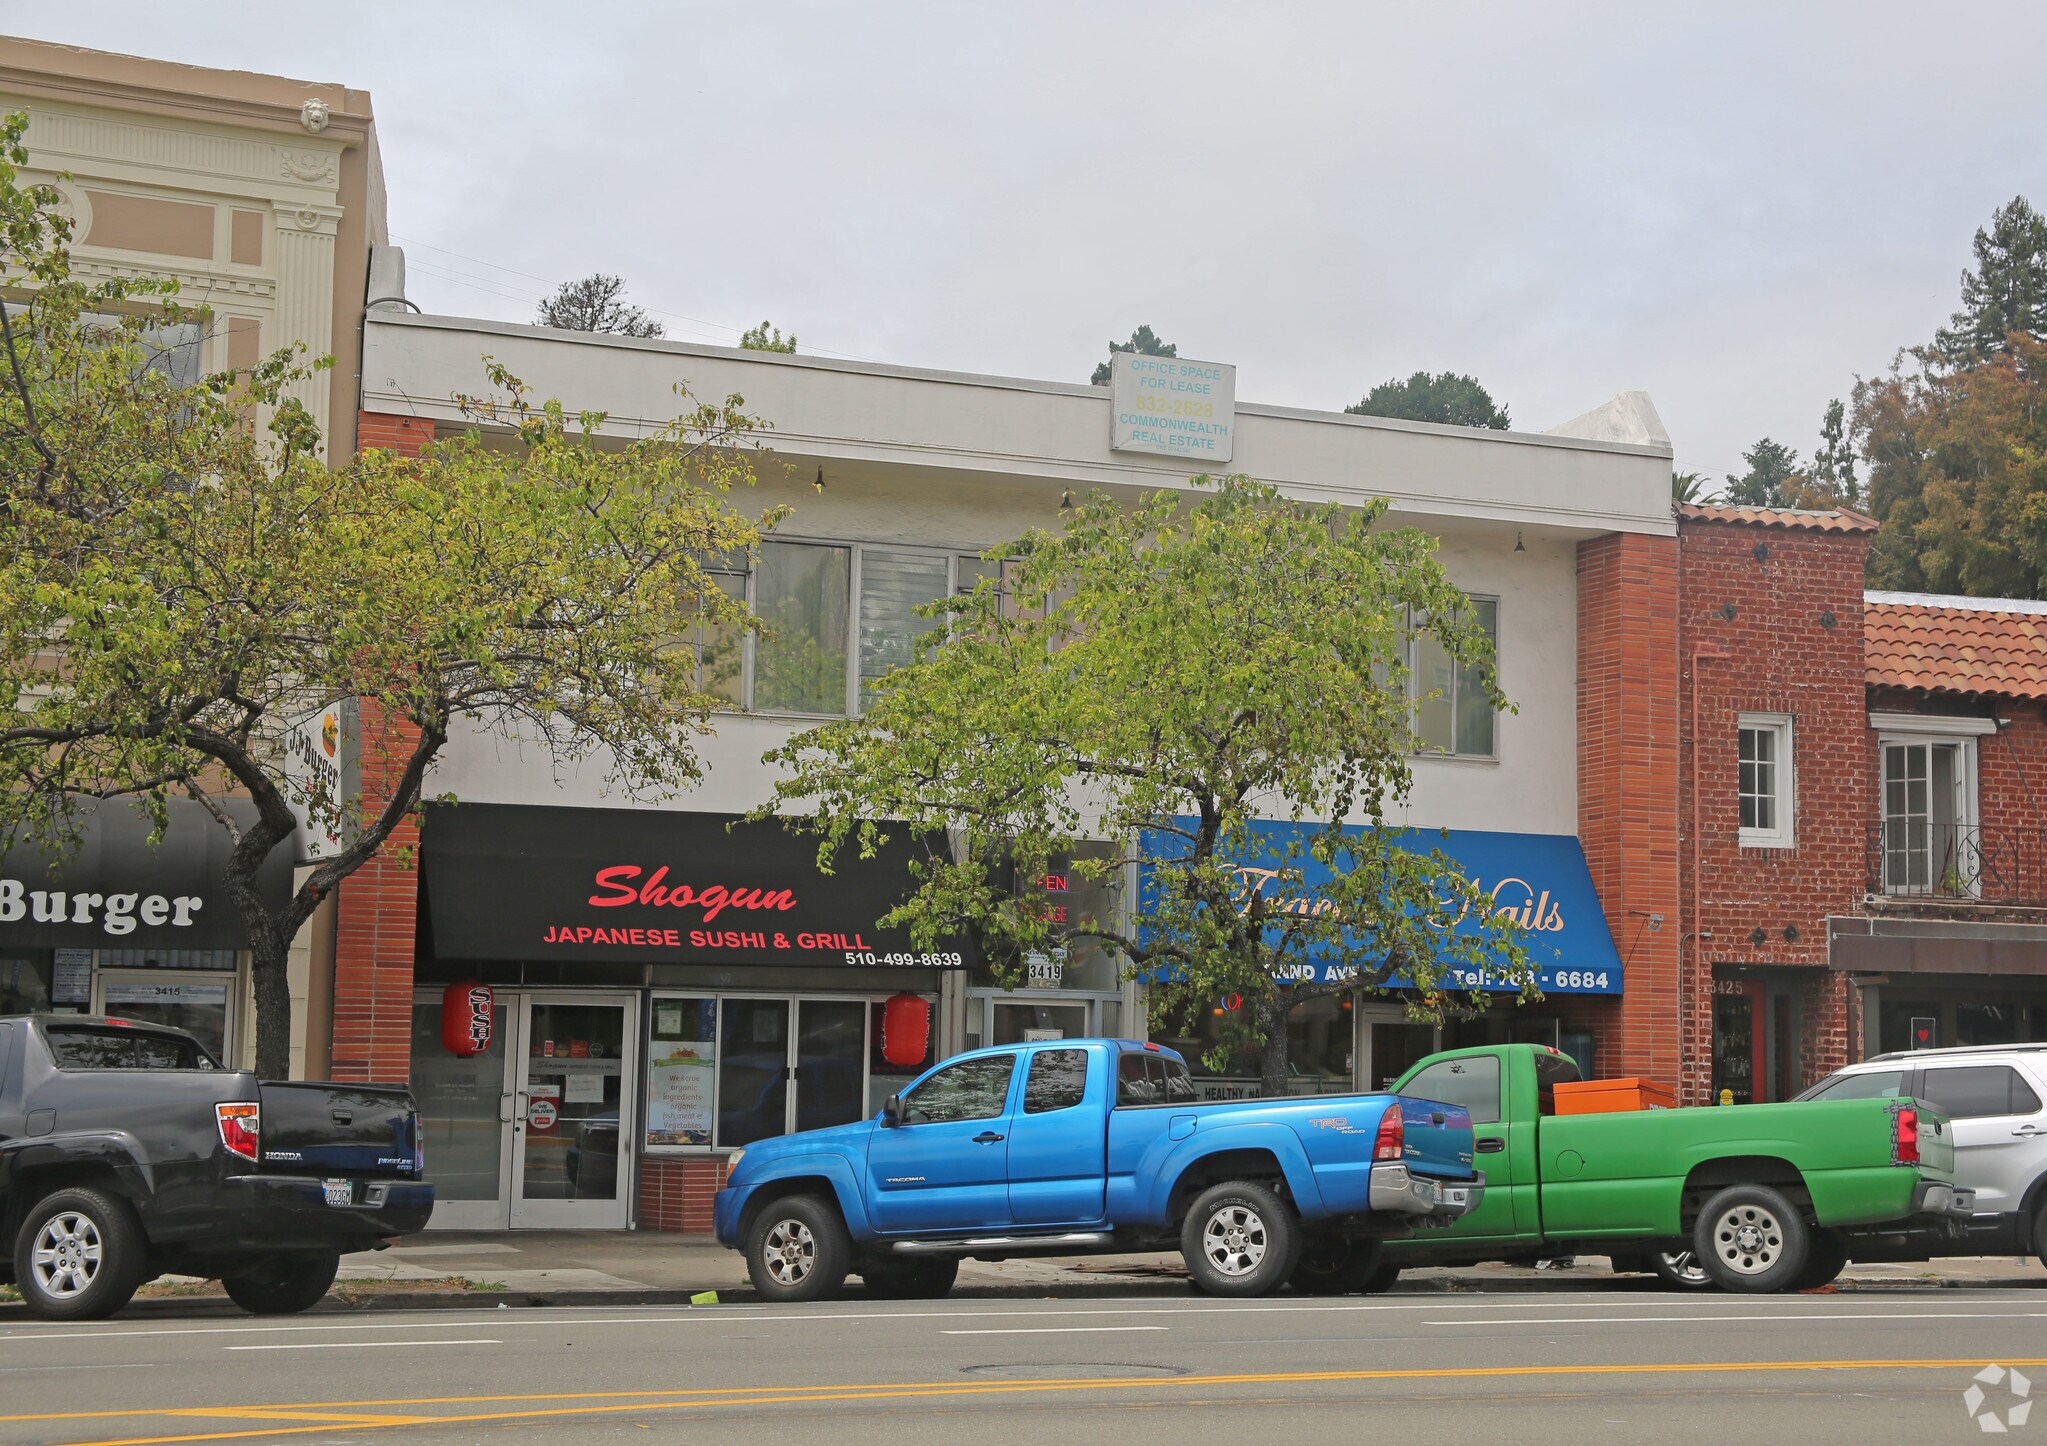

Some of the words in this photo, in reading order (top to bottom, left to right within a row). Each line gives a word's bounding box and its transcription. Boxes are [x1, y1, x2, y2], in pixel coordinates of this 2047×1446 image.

[1131, 359, 1176, 375] OFFICE
[1180, 365, 1221, 380] SPACE
[1140, 376, 1166, 389] FOR
[1170, 381, 1210, 394] LEASE
[1136, 394, 1213, 418] 832-2628
[1120, 413, 1228, 435] COMMONWEALTH
[1132, 430, 1165, 444] REAL
[1169, 434, 1215, 449] ESTATE
[588, 865, 798, 923] Shogun
[0, 879, 203, 935] Burger
[1427, 877, 1564, 931] Nails
[543, 926, 681, 946] JAPANESE
[690, 931, 766, 948] SUSHI
[773, 932, 791, 949] &
[797, 932, 871, 950] GRILL
[845, 952, 963, 967] 510-499-8639
[1030, 965, 1061, 979] 3419
[1453, 969, 1491, 986] Tel:
[1555, 971, 1609, 989] 6684
[155, 987, 180, 996] 3415
[469, 987, 491, 1050] SUSHI
[670, 1084, 697, 1093] organic
[1205, 1087, 1244, 1100] HEALTHY
[671, 1103, 697, 1111] organic
[265, 1151, 303, 1161] HONDA
